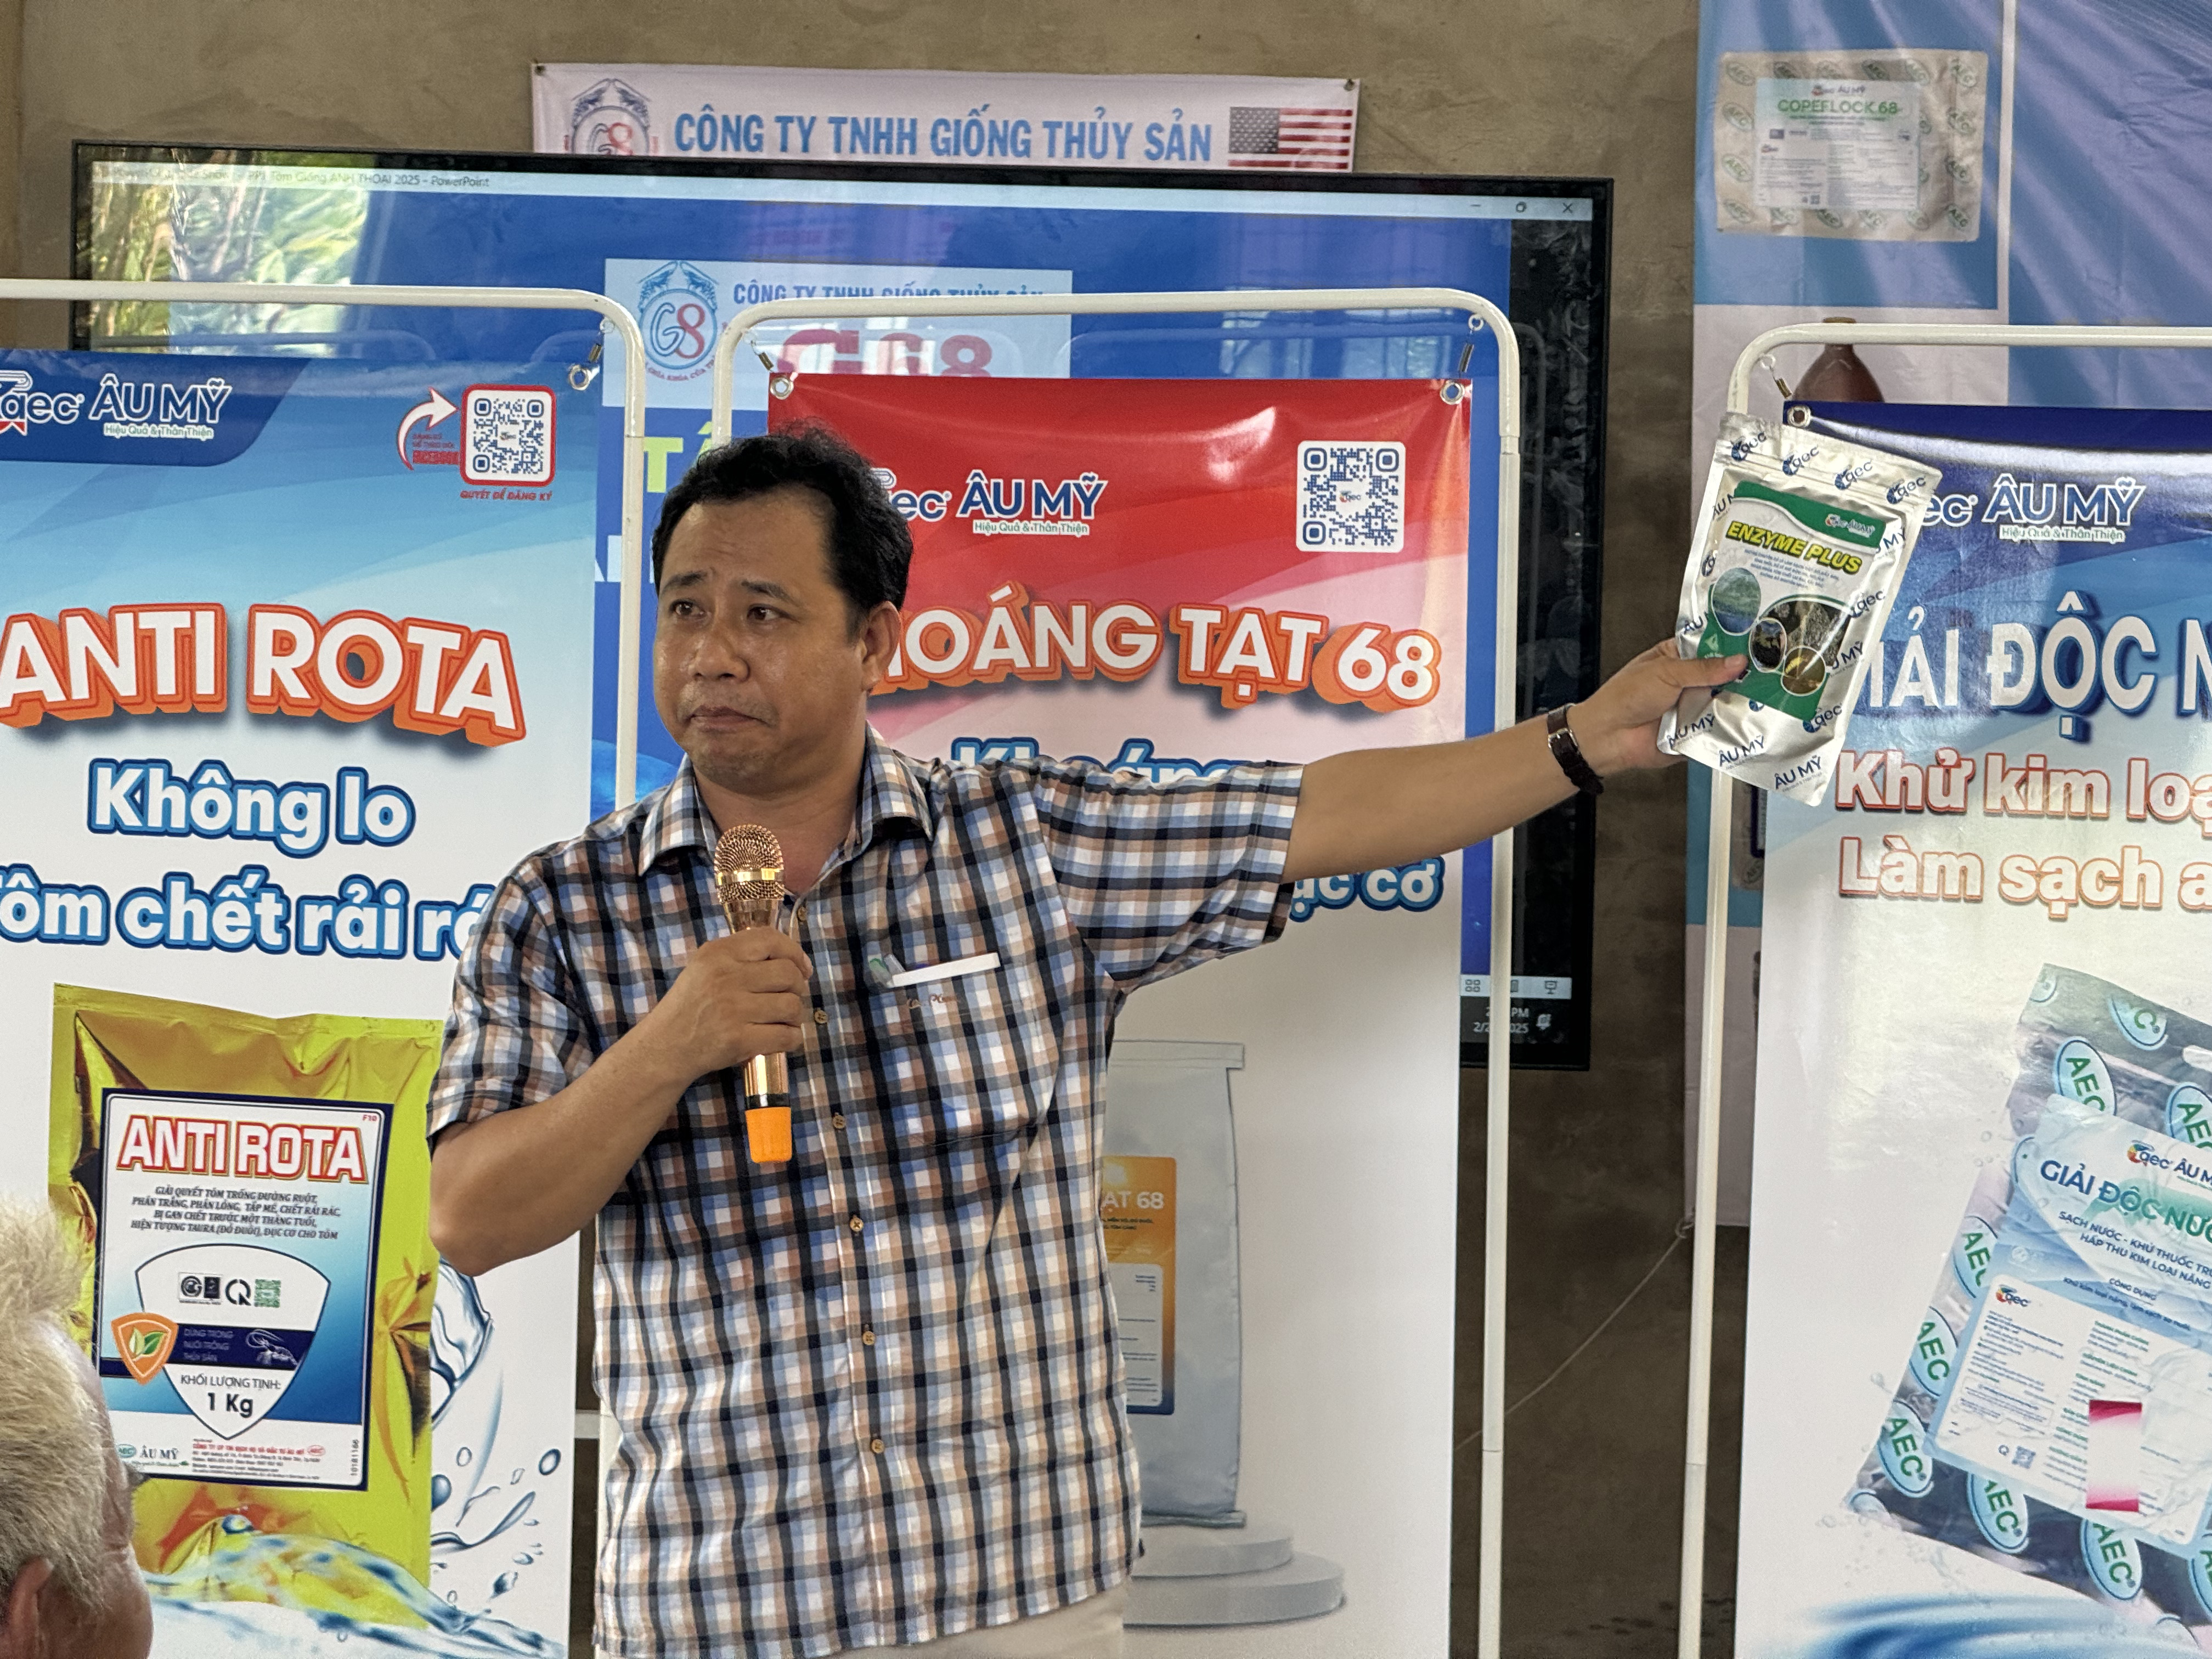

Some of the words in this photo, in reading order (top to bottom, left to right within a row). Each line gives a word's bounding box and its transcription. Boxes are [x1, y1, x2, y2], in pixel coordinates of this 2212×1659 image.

[674, 103, 764, 154] CÔNG
[775, 115, 816, 154] TY
[828, 116, 917, 156] TNHH
[930, 104, 1032, 158] GIỐNG
[1043, 106, 1133, 161] THỦY
[1144, 108, 1211, 162] SẢN
[1878, 101, 1898, 114] 68
[394, 173, 420, 185] 2025
[431, 176, 490, 188] PowerPoint
[733, 279, 787, 304] CÔNG
[88, 373, 155, 422] ÂU
[160, 377, 233, 424] MỸ
[890, 490, 947, 522] ec
[956, 469, 1025, 518] ÂU
[1032, 471, 1108, 520] MỸ
[1897, 477, 1926, 497] aec
[1921, 494, 1973, 527] ec
[1982, 473, 2057, 524] ÂU
[2063, 476, 2146, 526] MỸ
[974, 522, 997, 535] Hiệu
[1725, 520, 1809, 558] ENZYME
[1803, 543, 1863, 575] PLUS
[883, 583, 1162, 681] OÁNG
[1173, 603, 1328, 706] TẠT
[1334, 623, 1438, 707] 68
[1868, 606, 1960, 710] IẢI
[1986, 590, 2158, 739] ĐỘC
[0, 603, 224, 720] ANTI
[247, 605, 525, 741] ROTA
[1719, 747, 1740, 768] ÂU
[1741, 734, 1765, 757] MỸ
[1774, 769, 1796, 791] ÂU
[1797, 754, 1821, 778] MỸ
[88, 759, 330, 859] Không
[336, 767, 416, 846] lo
[1836, 747, 1976, 813] Khử
[1983, 752, 2111, 818] kim
[2126, 757, 2212, 839] loạ
[1361, 857, 1444, 912] cơ
[1838, 835, 1984, 901] Làm
[1999, 844, 2164, 920] sạch
[0, 864, 110, 945] ôm
[116, 865, 290, 955] chết
[296, 874, 409, 958] rải
[414, 884, 496, 961] rá
[1511, 1007, 1530, 1018] PM
[116, 1115, 229, 1176] ANTI
[234, 1121, 369, 1184] ROTA
[2174, 1158, 2200, 1178] ÂU
[1102, 1190, 1132, 1213] ẠT
[1137, 1191, 1164, 1209] 68
[2040, 1160, 2096, 1195] GIẢI
[2098, 1180, 2162, 1220] ĐỘC
[2058, 1211, 2089, 1228] SẠCH
[2156, 1248, 2194, 1269] THUỐC
[2129, 1251, 2151, 1266] KIM
[1917, 1321, 1951, 1382] AEC
[180, 1373, 208, 1386] KHỐI
[210, 1375, 251, 1390] LƯỢNG
[207, 1392, 215, 1411] 1
[226, 1393, 254, 1418] Kg
[139, 1444, 157, 1459] ÂU
[1888, 1417, 1923, 1477] AEC
[1985, 1480, 2019, 1533] AEC
[2092, 1522, 2132, 1584] AEC
